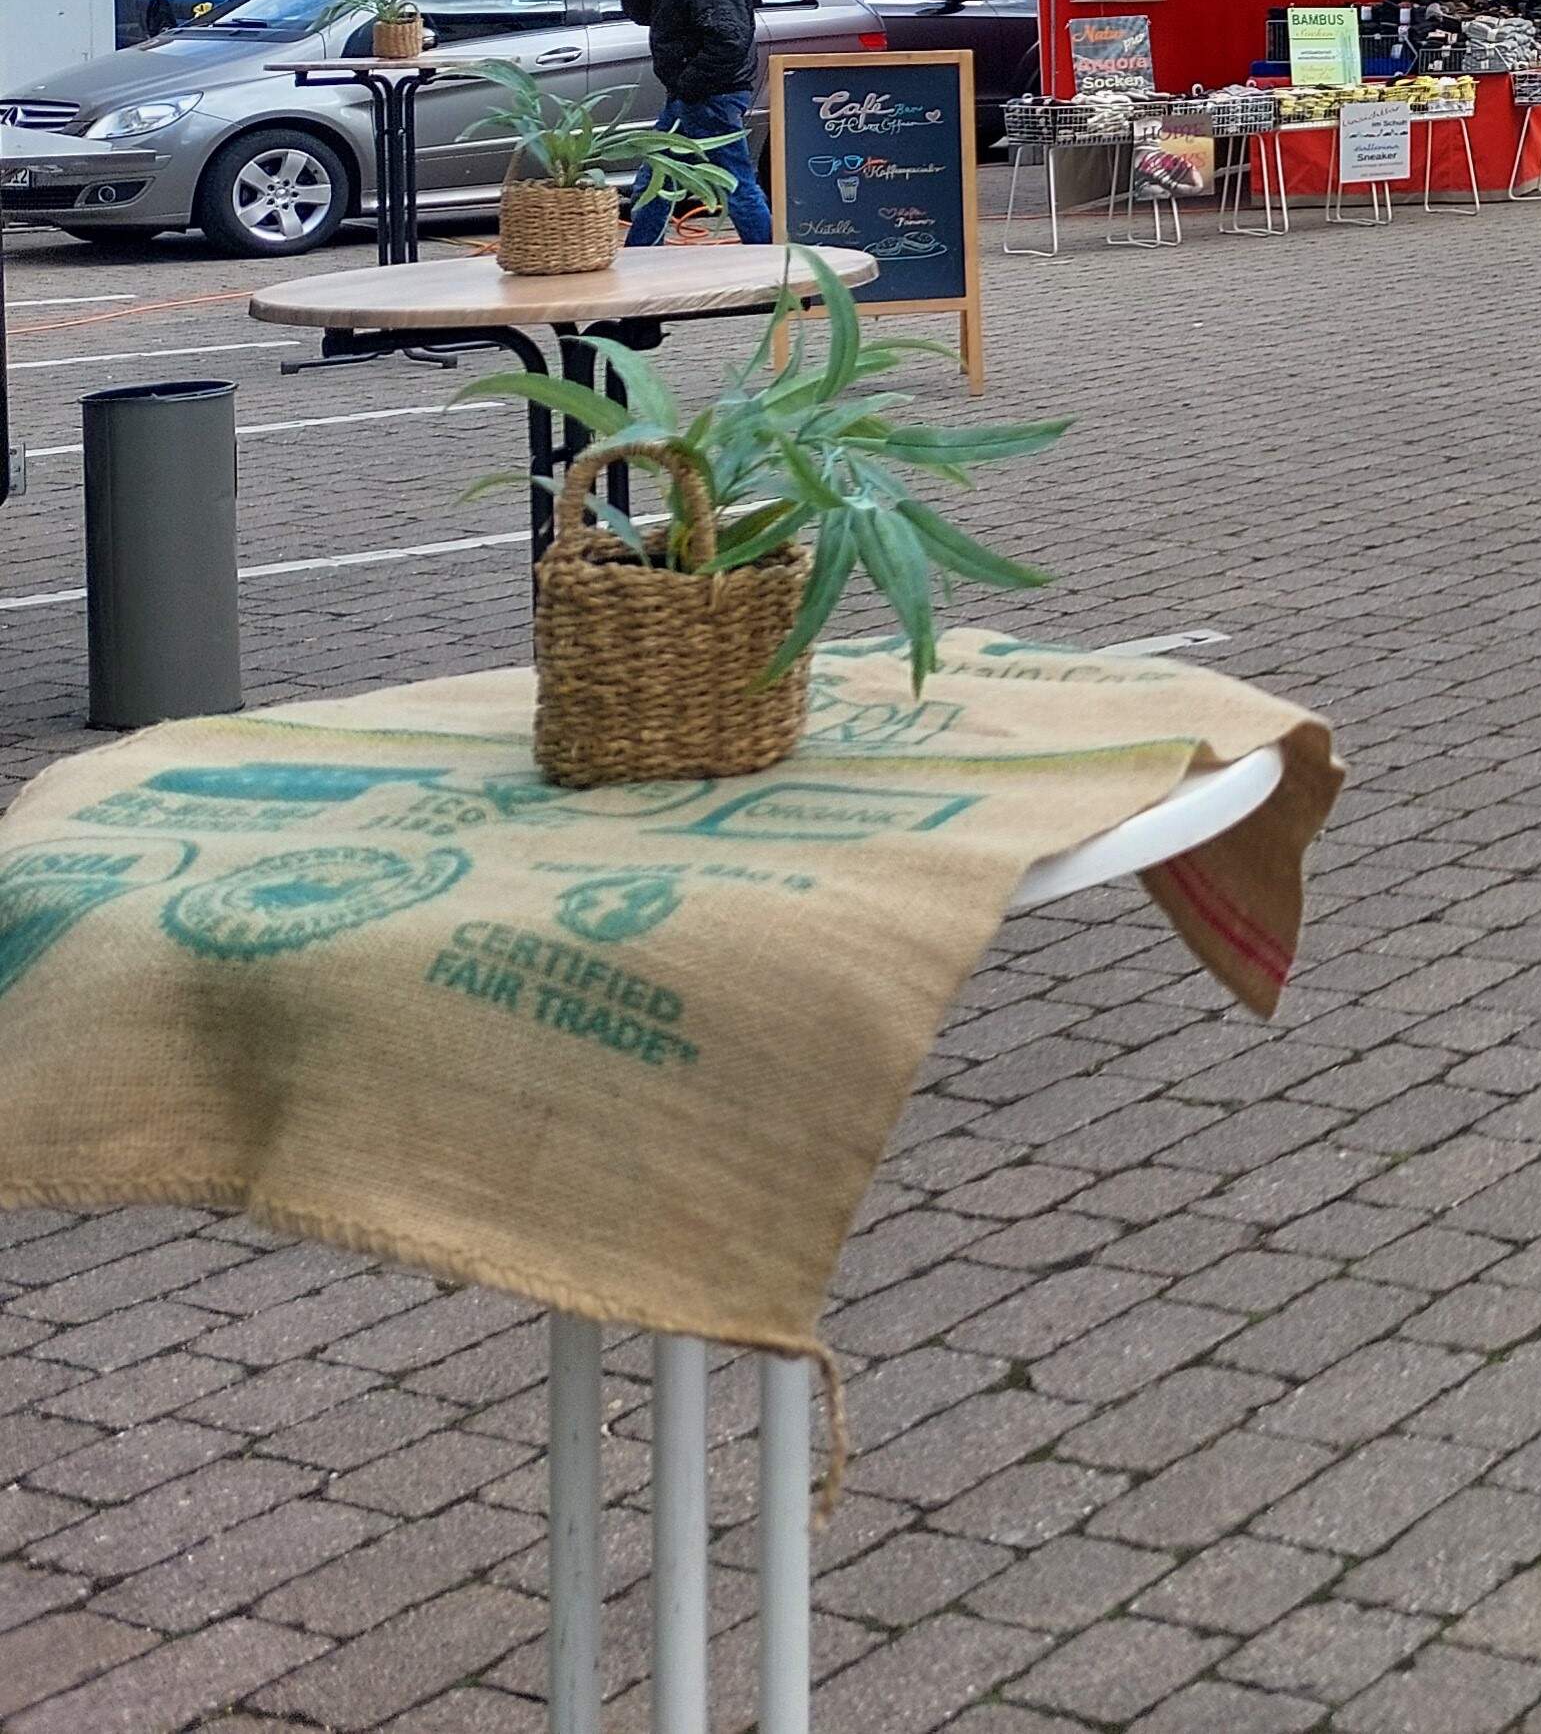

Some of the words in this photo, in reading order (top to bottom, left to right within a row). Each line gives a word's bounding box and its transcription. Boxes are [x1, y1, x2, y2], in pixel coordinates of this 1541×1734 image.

[1292, 14, 1344, 26] BAMBUS
[1082, 74, 1145, 90] Socken
[812, 90, 895, 129] Café
[1357, 152, 1397, 162] Sneaker
[741, 800, 902, 827] ORGANIC
[423, 947, 525, 1014] FAIR
[450, 918, 684, 1024] CERTIFIED
